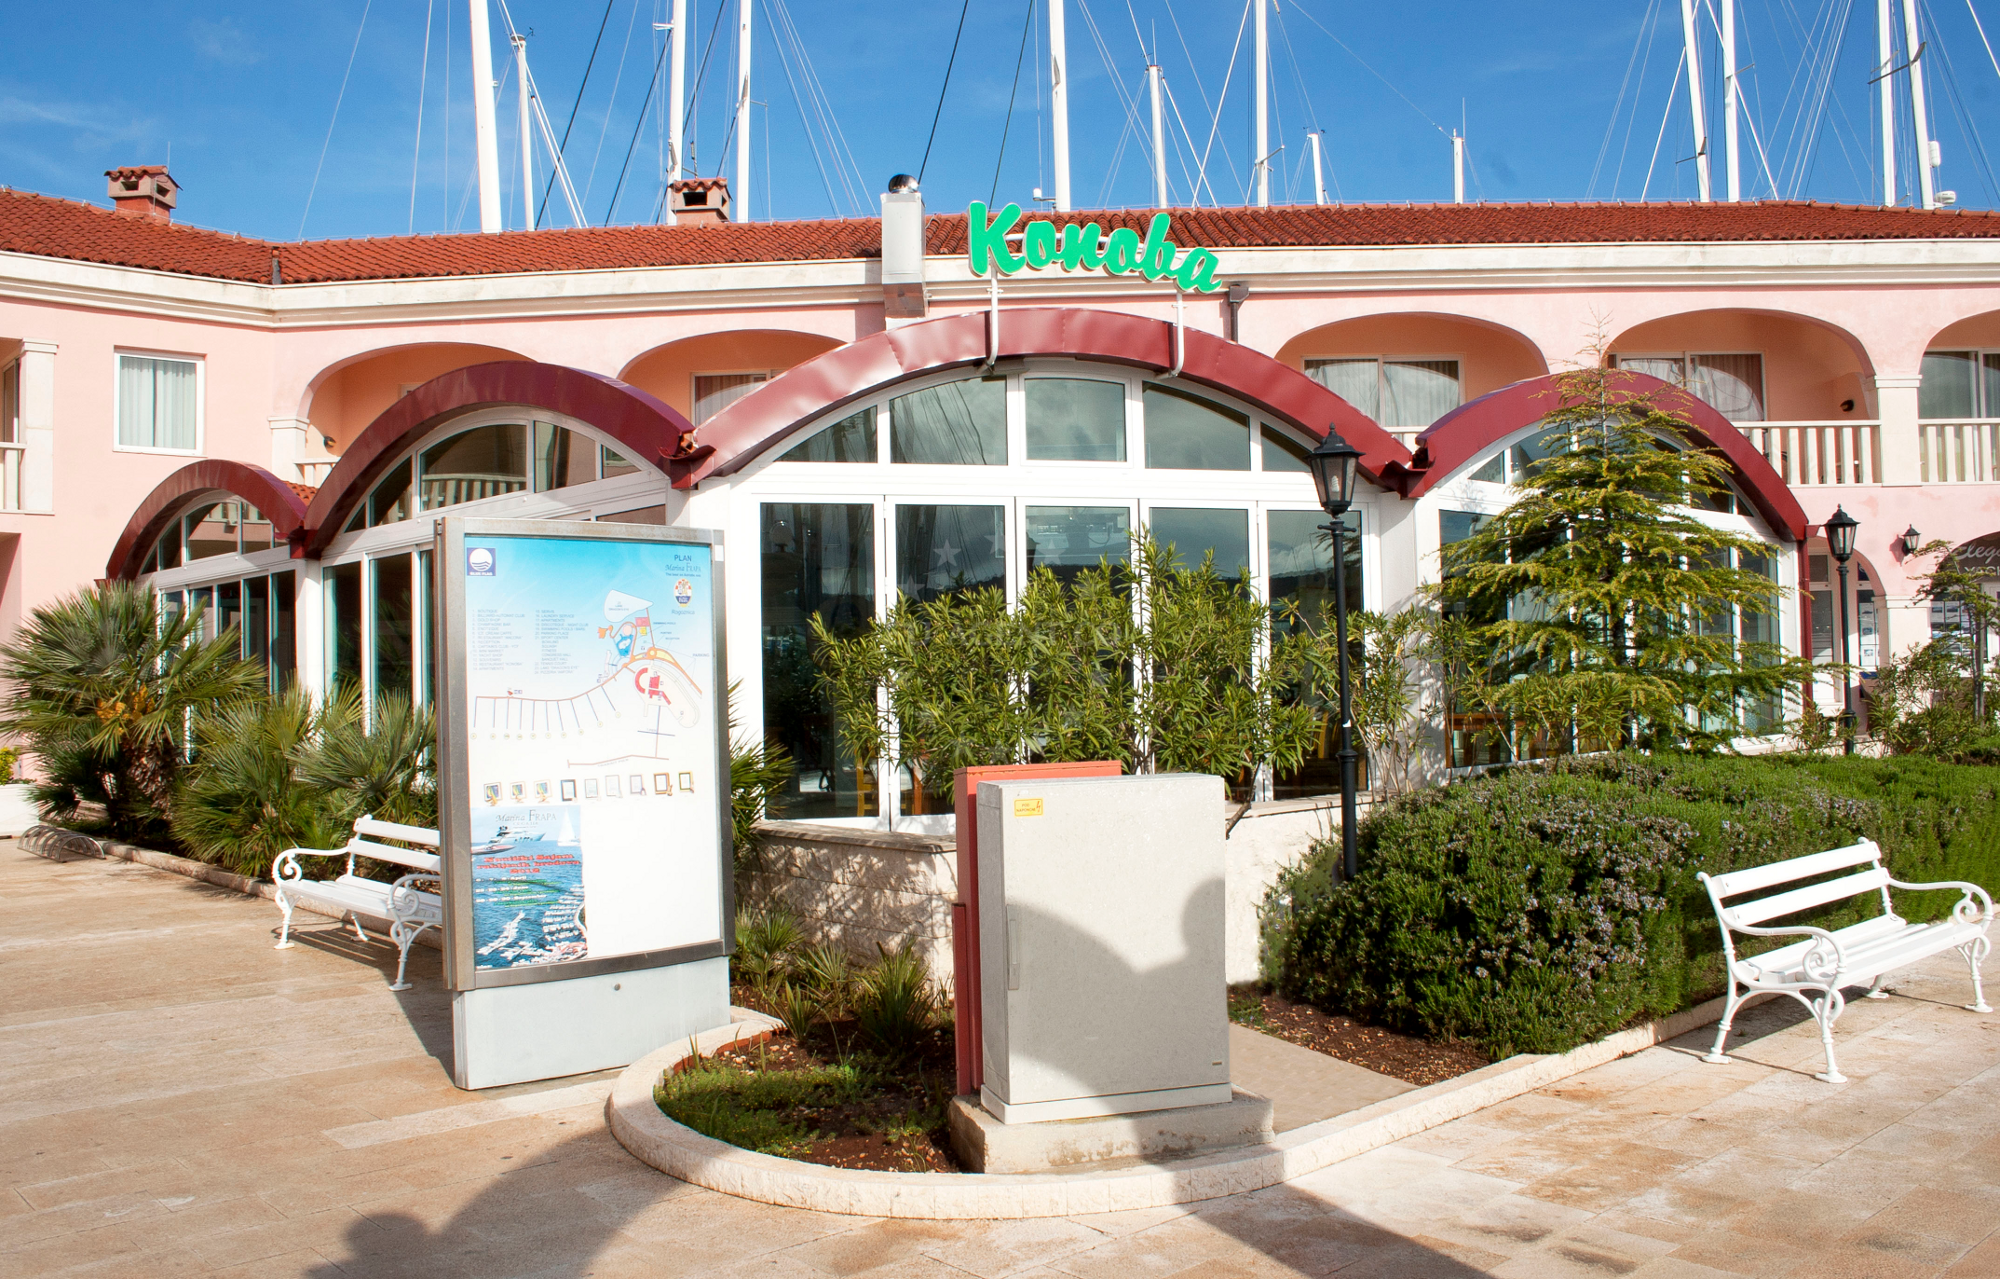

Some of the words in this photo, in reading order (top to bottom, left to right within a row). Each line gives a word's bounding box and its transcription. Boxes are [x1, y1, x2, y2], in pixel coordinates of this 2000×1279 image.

[968, 200, 1222, 294] Konoba
[674, 554, 692, 562] PLAN
[496, 814, 526, 822] Marina
[529, 809, 557, 821] FRAPA
